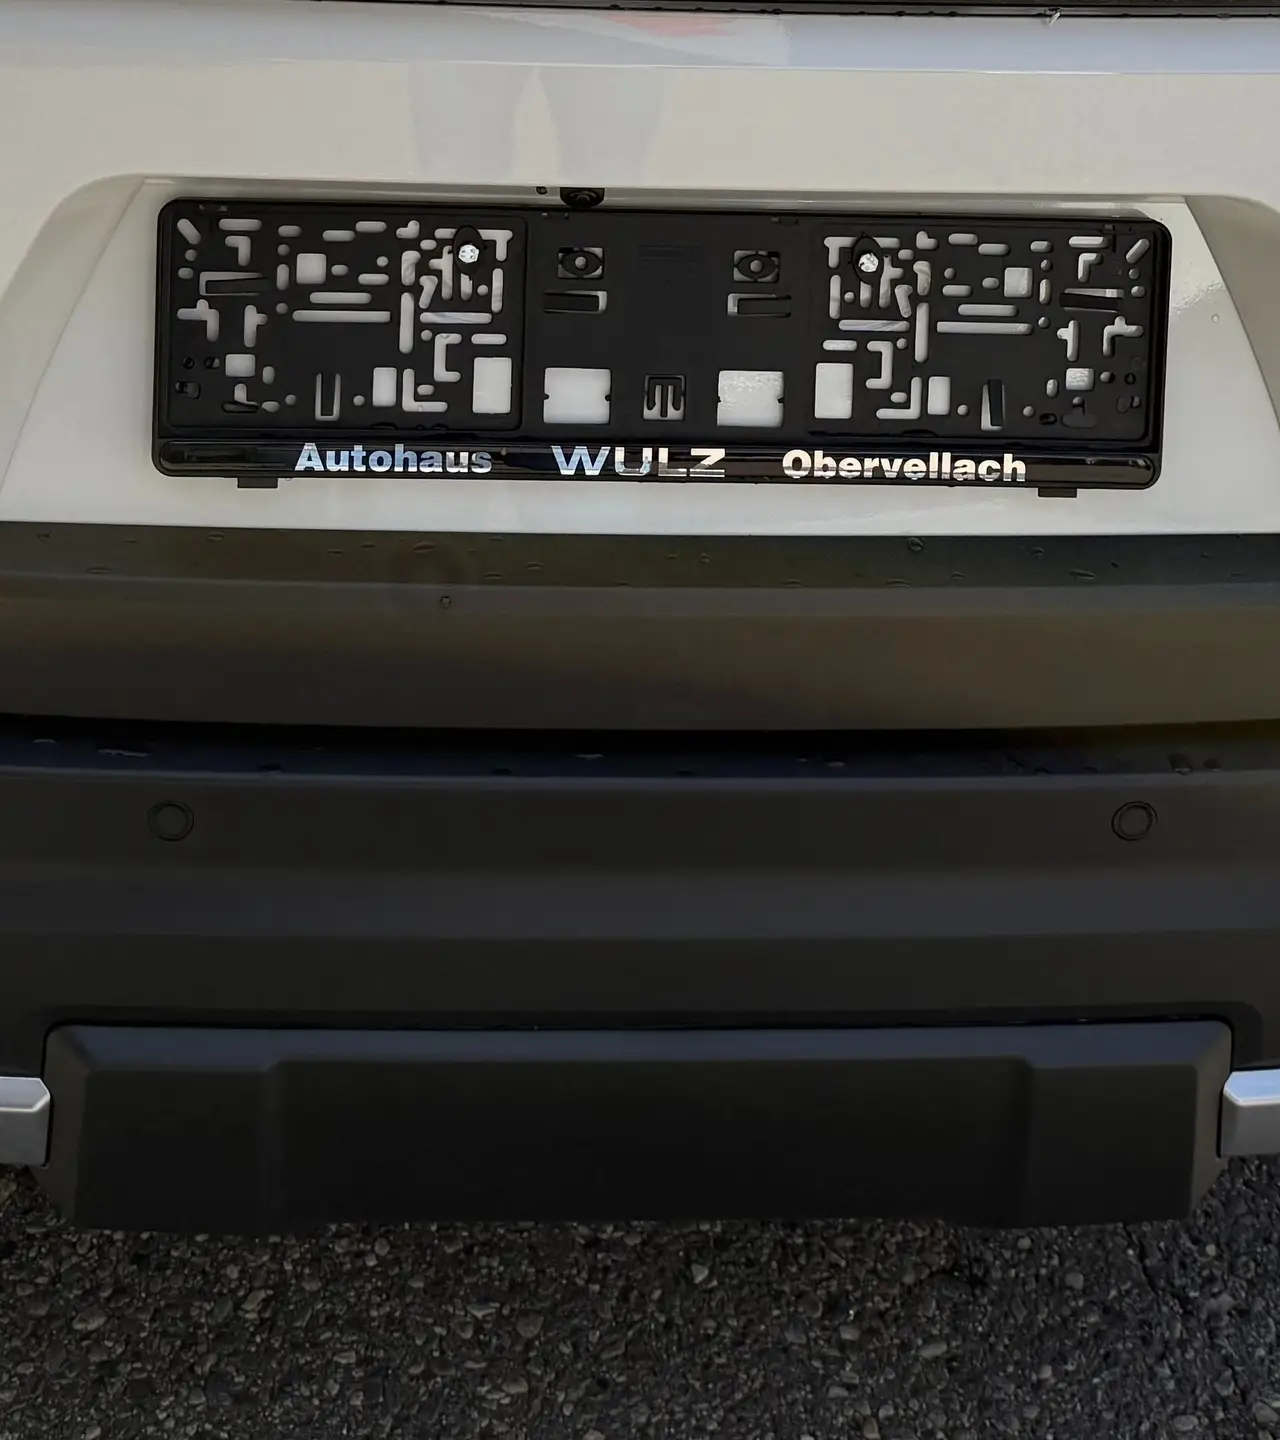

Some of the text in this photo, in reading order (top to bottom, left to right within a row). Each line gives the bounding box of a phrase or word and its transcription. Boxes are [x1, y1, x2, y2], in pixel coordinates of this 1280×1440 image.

[294, 442, 1027, 482] Autohaus WULZ Obervellach
